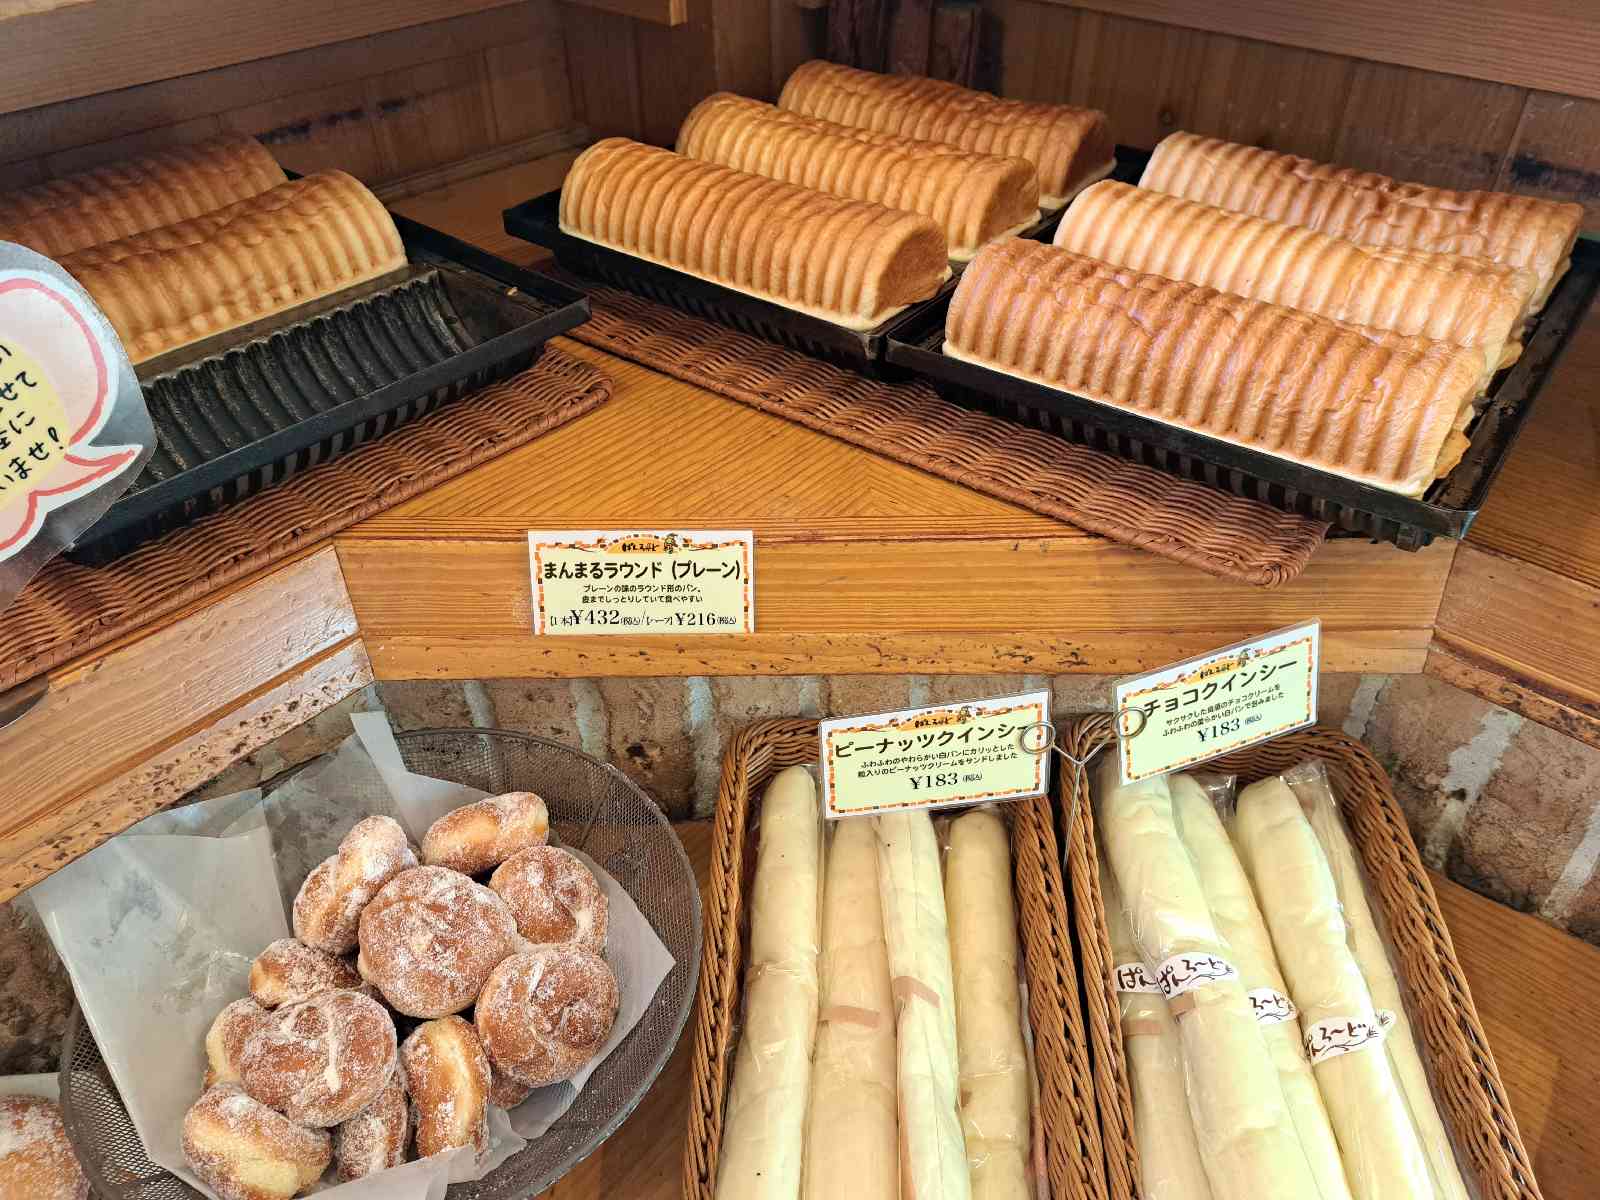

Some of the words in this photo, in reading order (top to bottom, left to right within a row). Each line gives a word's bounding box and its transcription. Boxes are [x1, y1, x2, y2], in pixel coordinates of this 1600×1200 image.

[1143, 660, 1298, 719] チョコクインシー
[1197, 717, 1240, 743] ¥183
[908, 772, 959, 790] ¥183
